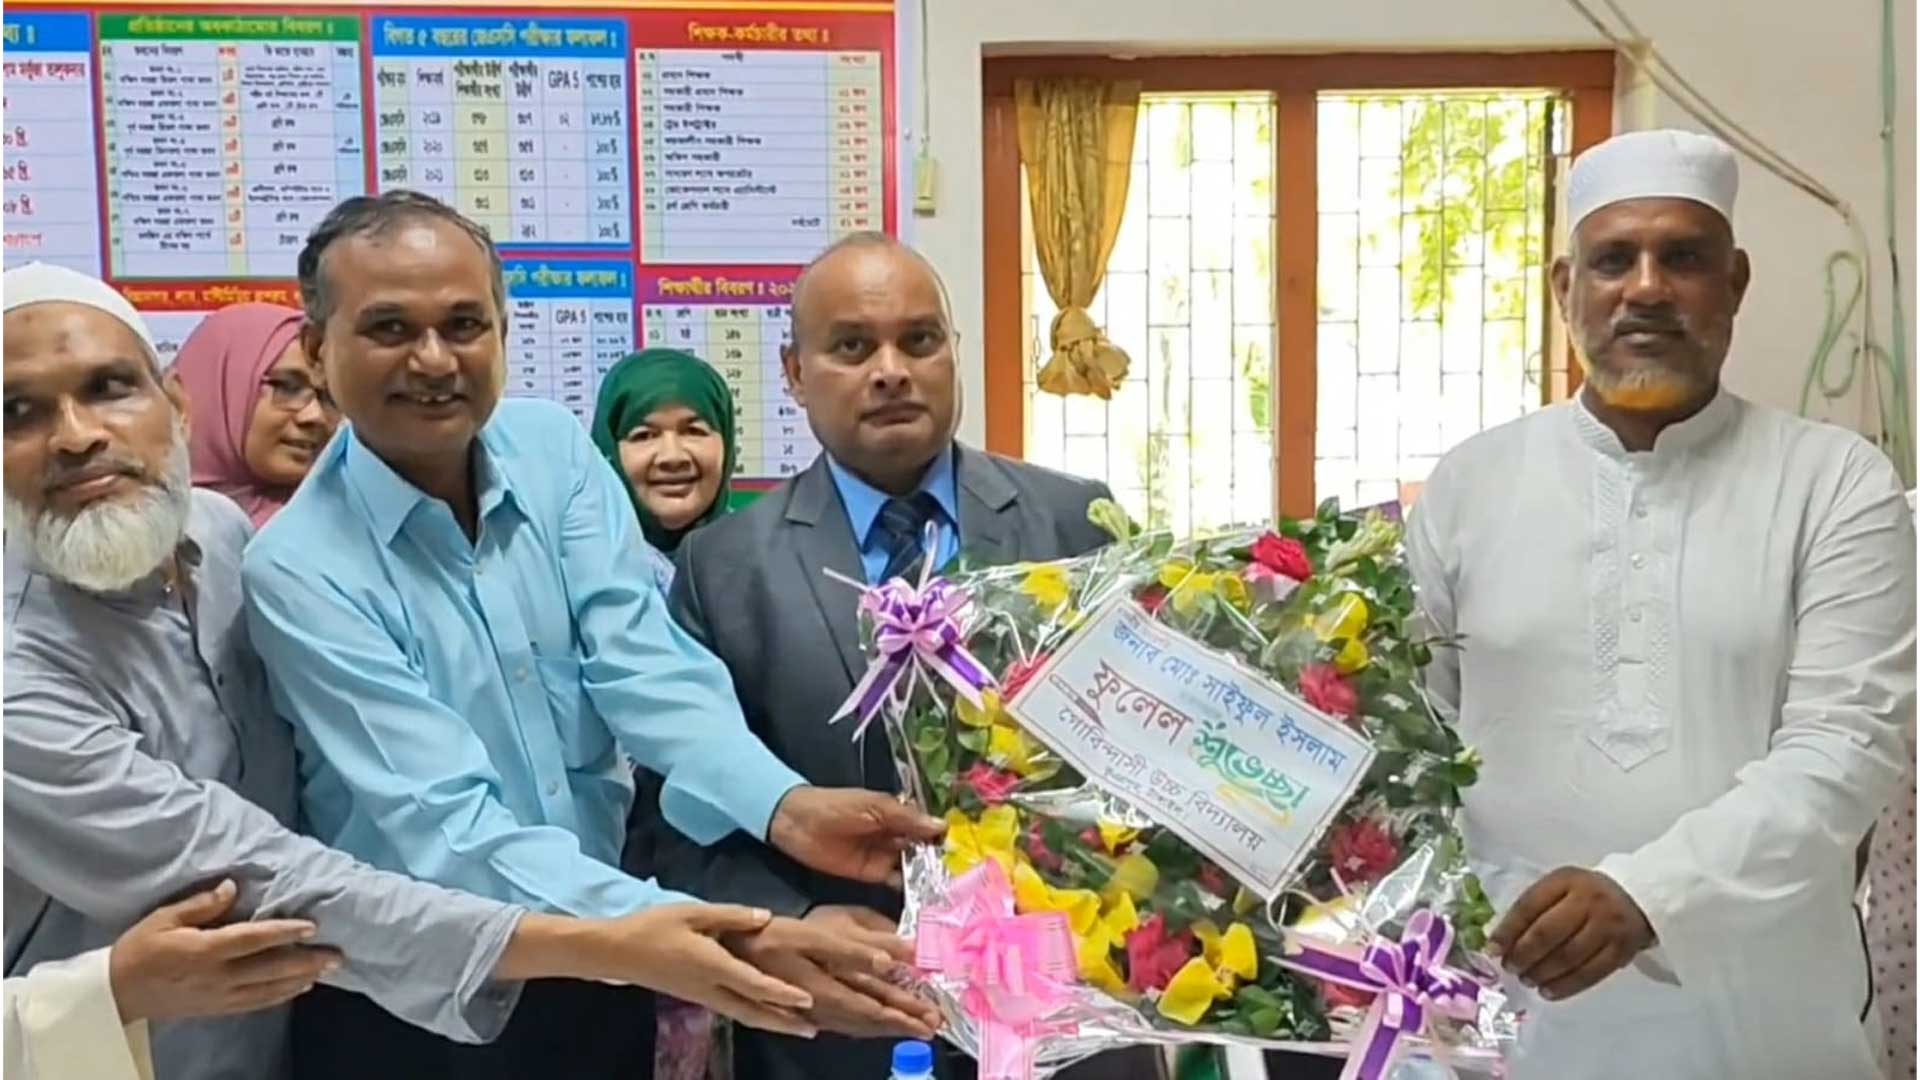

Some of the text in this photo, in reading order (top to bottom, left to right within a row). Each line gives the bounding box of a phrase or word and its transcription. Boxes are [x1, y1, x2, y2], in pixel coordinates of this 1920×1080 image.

[383, 20, 414, 47] বিগত
[687, 21, 787, 43] শিক্ষক-কর্মচারীর
[792, 27, 819, 43] তথ্য
[548, 70, 580, 87] GPA 5
[715, 275, 754, 297] বিবরণ
[556, 308, 578, 325] GPA
[580, 309, 587, 325] 5
[1085, 656, 1195, 748] ফুলেল
[1112, 619, 1164, 665] জনাব
[1201, 672, 1278, 734] সাইফুল
[1275, 710, 1348, 775] ইসলাম
[1056, 705, 1267, 853] গোবিন্দাসী উচ্চ বিদ্যালয়
